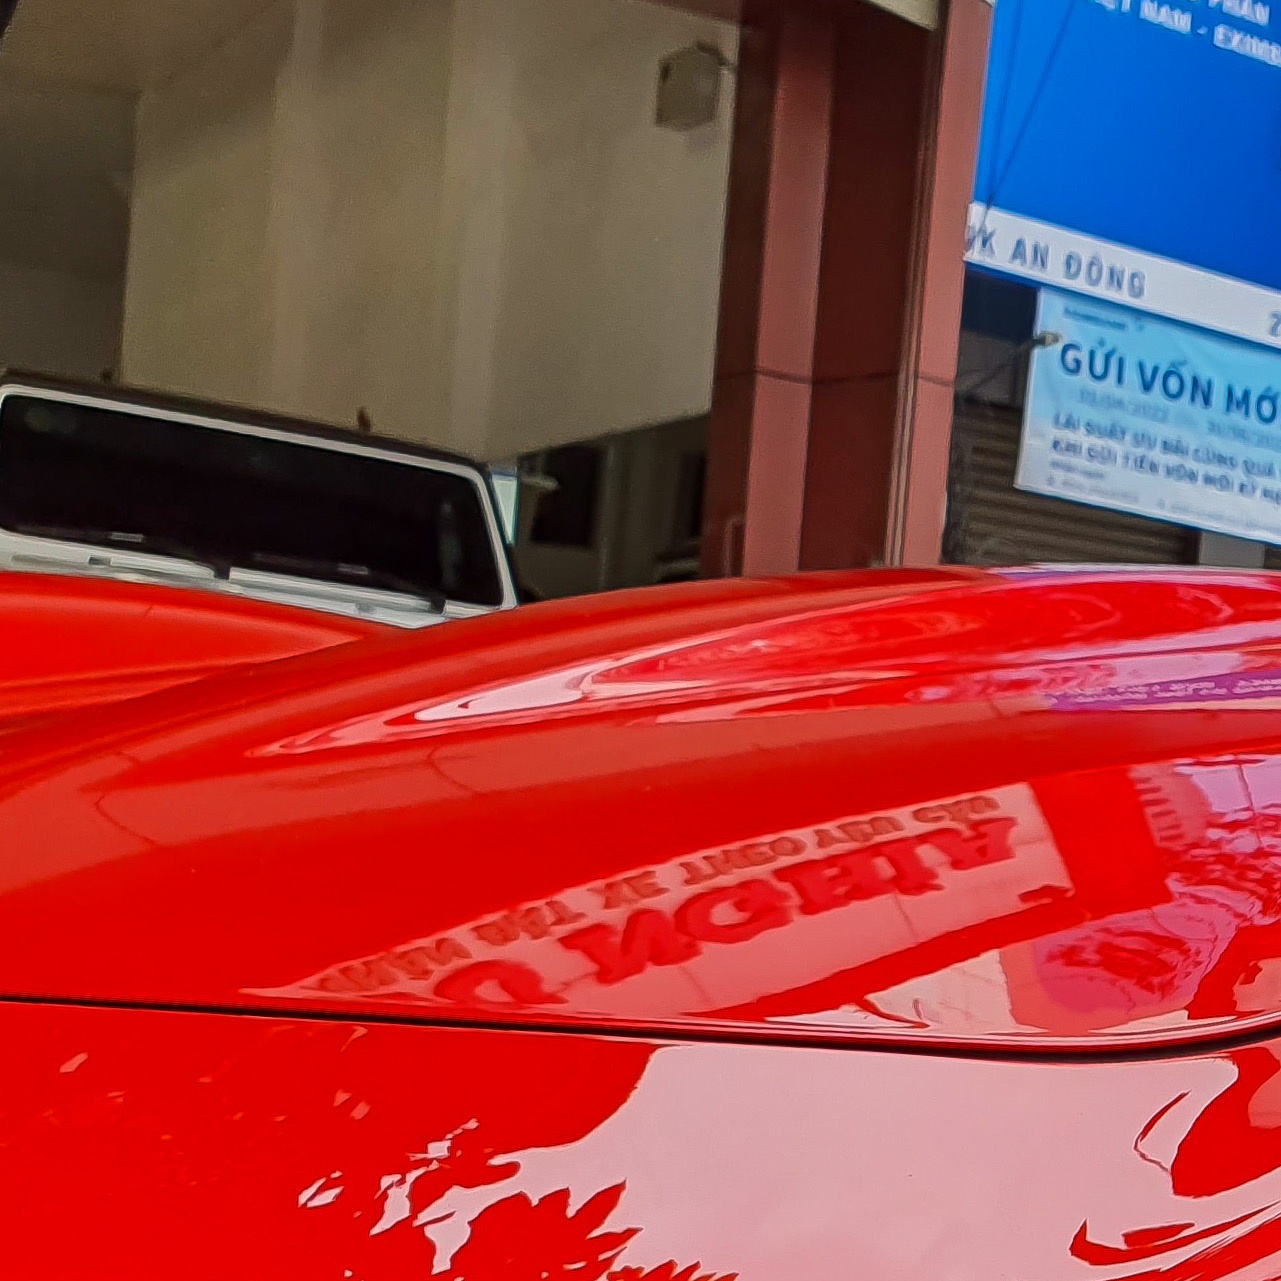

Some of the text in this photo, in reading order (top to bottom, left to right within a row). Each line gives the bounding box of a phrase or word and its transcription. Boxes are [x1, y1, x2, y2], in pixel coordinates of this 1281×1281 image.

[1010, 237, 1051, 270] AN
[1062, 251, 1147, 299] ĐÔNG
[1060, 337, 1125, 385] GỬI
[1137, 357, 1214, 408] VỐN
